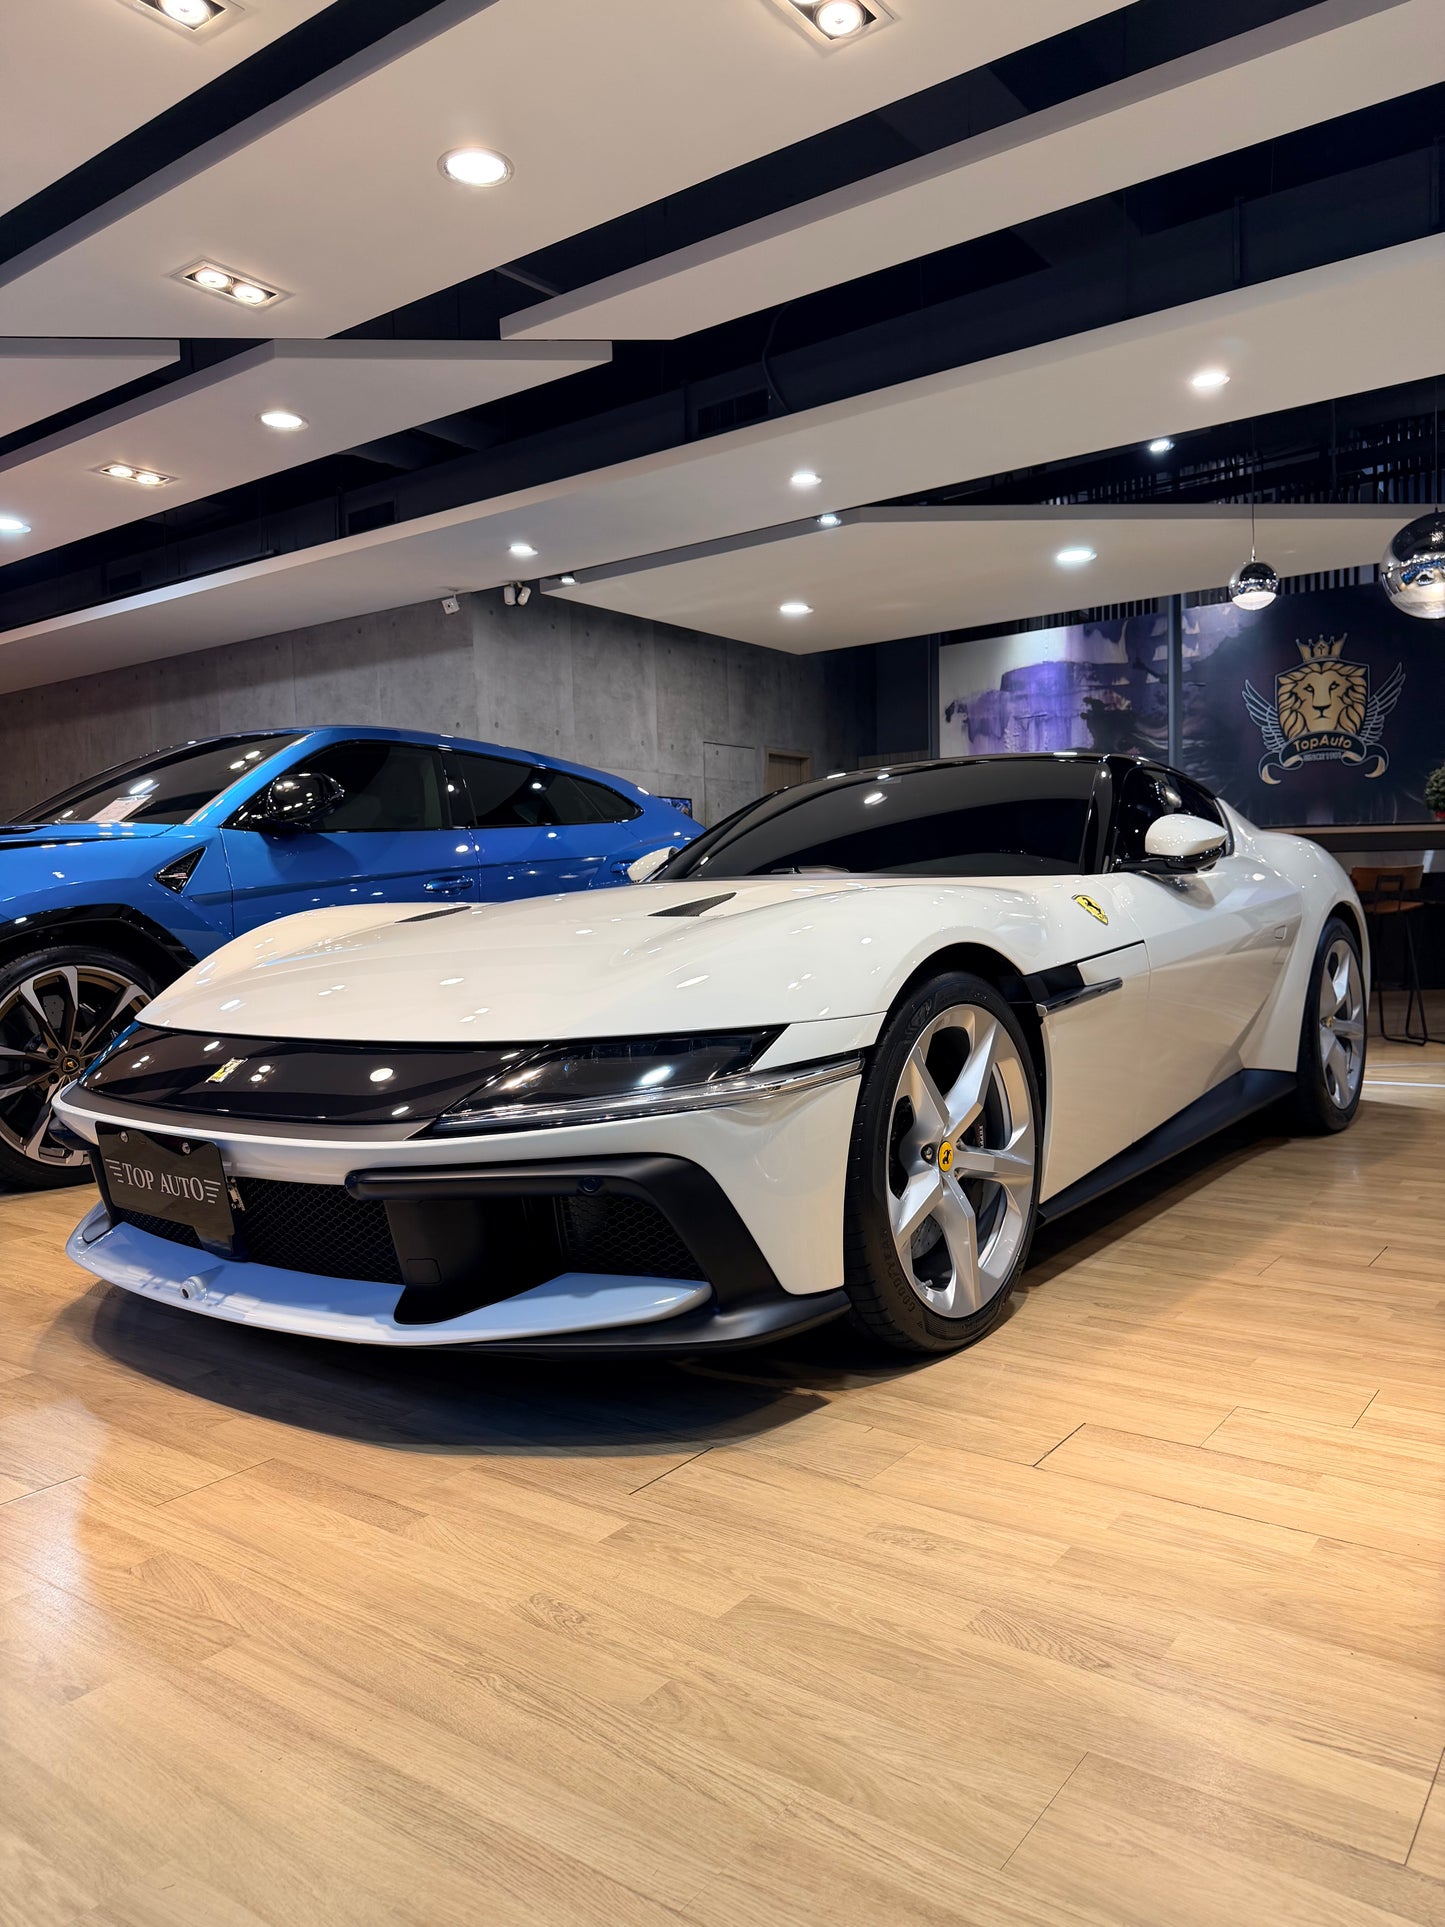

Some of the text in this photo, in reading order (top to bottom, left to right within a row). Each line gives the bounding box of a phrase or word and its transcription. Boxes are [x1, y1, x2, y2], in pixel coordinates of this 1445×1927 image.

[1293, 734, 1352, 752] TopAuto
[122, 1162, 204, 1202] TOP AUTO
